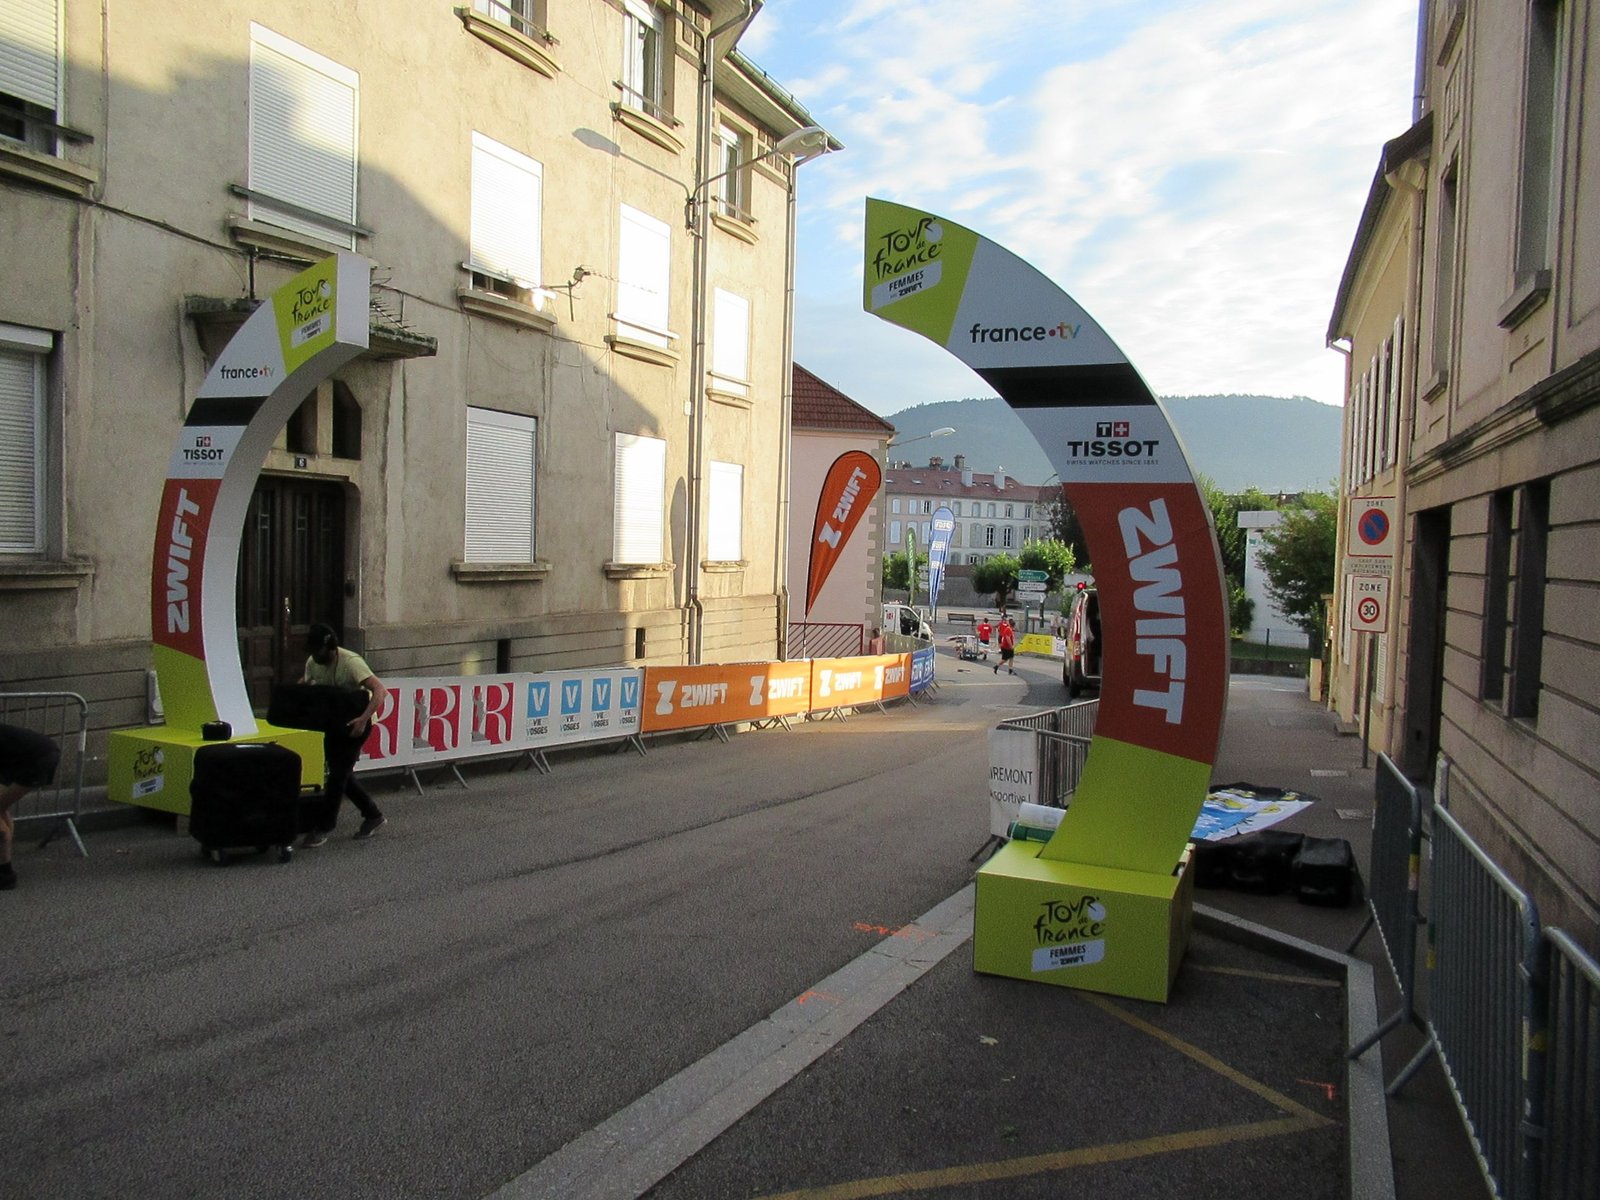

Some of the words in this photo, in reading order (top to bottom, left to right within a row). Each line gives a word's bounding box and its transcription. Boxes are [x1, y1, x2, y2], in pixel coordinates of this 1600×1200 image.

[873, 248, 942, 279] france
[889, 270, 924, 291] FEMMES
[183, 449, 224, 461] TISSOT
[1067, 440, 1159, 457] TISSOT
[832, 466, 867, 523] ZWIFT
[166, 488, 200, 633] ZWIFT
[1359, 583, 1382, 592] ZONE
[1118, 498, 1186, 724] ZWIFT
[1363, 604, 1376, 616] 30
[532, 687, 547, 711] V
[565, 685, 579, 709] V
[596, 683, 608, 705] V
[624, 681, 636, 703] V
[680, 683, 728, 708] ZWIFT
[768, 676, 804, 699] ZWIFT
[1034, 914, 1105, 944] france
[1050, 945, 1086, 958] FEMMES
